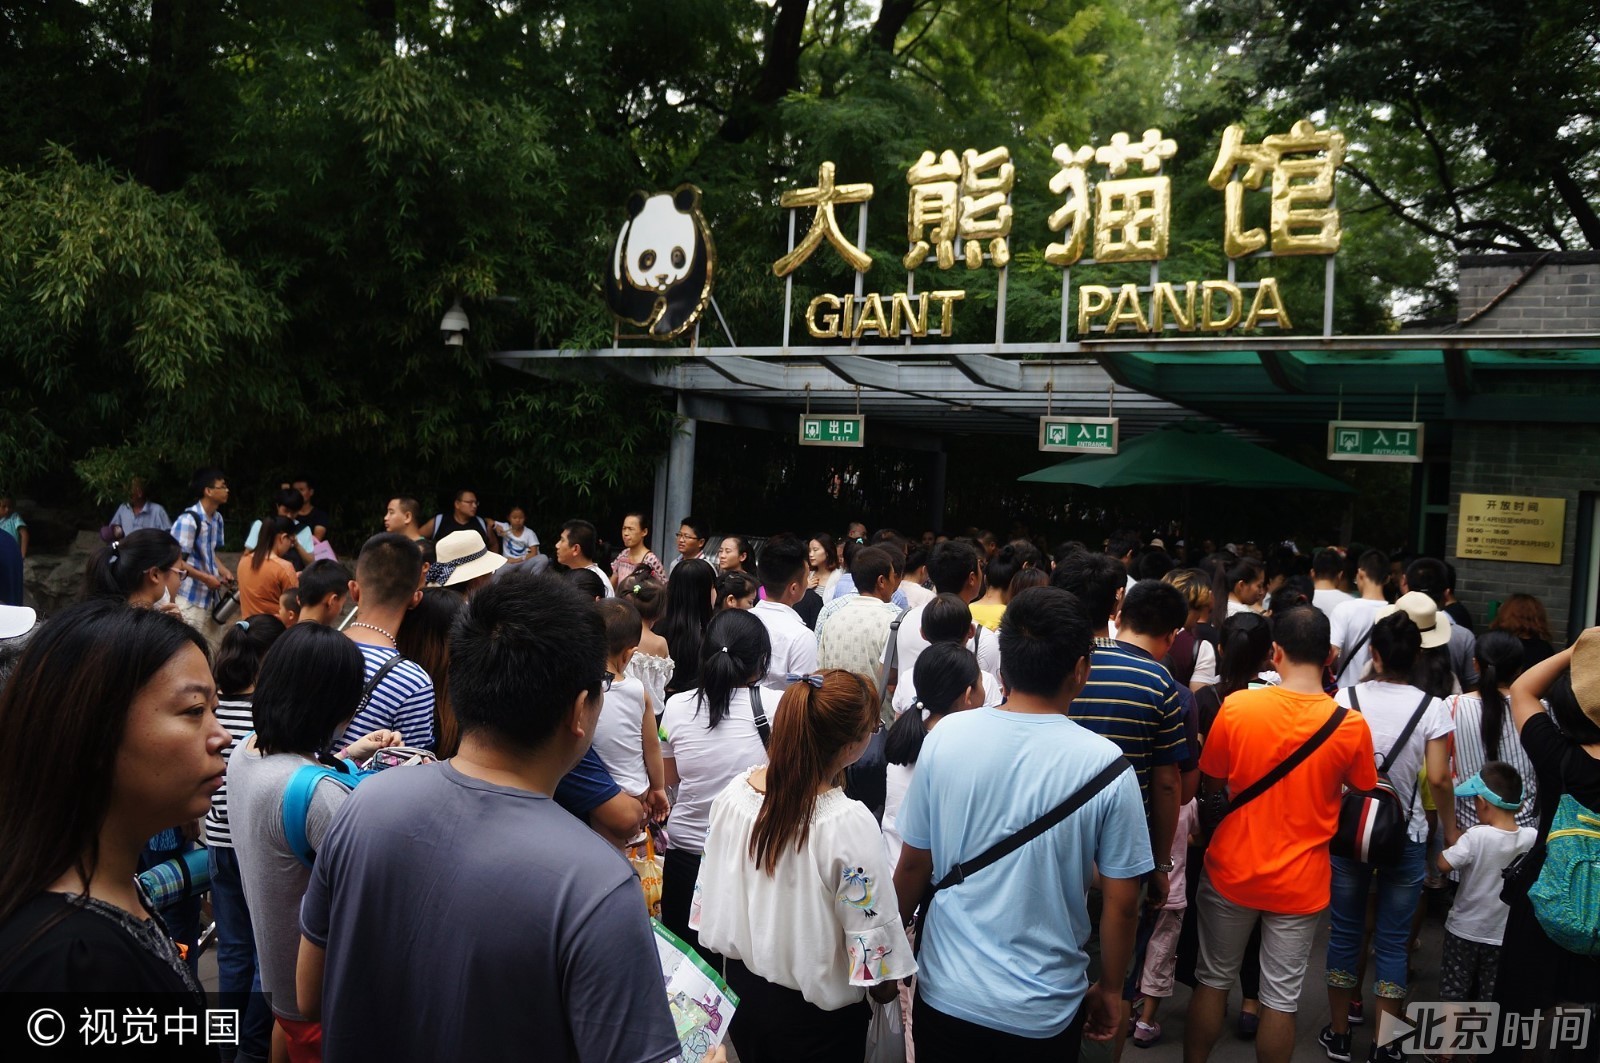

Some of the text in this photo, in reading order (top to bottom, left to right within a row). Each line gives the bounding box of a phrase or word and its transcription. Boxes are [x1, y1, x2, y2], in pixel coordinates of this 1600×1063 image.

[773, 119, 1346, 278] 大熊猫馆
[805, 277, 1293, 339] GIANT PANDA
[829, 420, 853, 434] 出口
[1077, 424, 1107, 439] 入口
[1373, 430, 1410, 446] 入口
[1372, 448, 1410, 456] ENTRANCE
[1486, 500, 1539, 512] 开放时间
